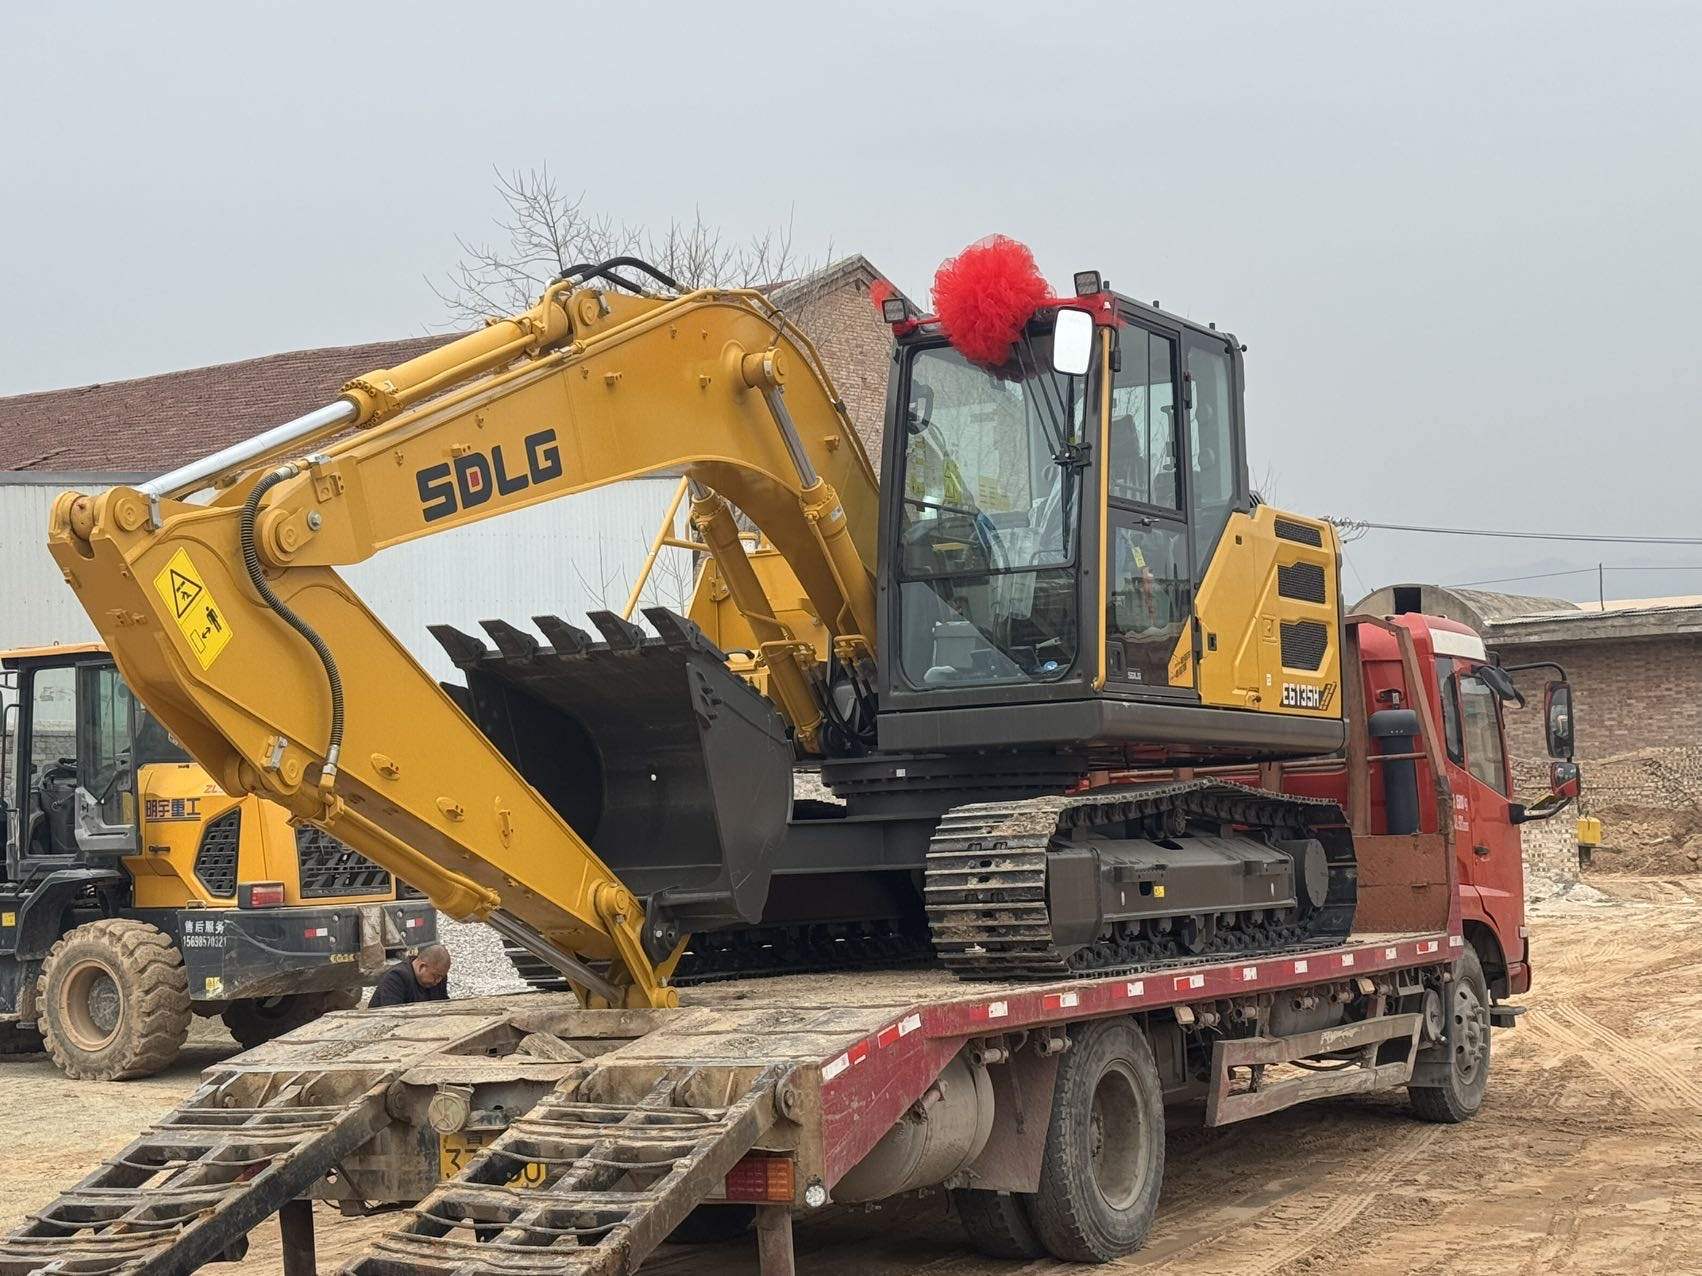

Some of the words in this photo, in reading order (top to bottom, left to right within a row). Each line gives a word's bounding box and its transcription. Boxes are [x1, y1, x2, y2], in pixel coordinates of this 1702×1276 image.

[416, 428, 562, 523] SDLG
[1282, 682, 1320, 707] E6135H
[146, 798, 201, 818] 明宇重工
[184, 920, 225, 934] 售后服务
